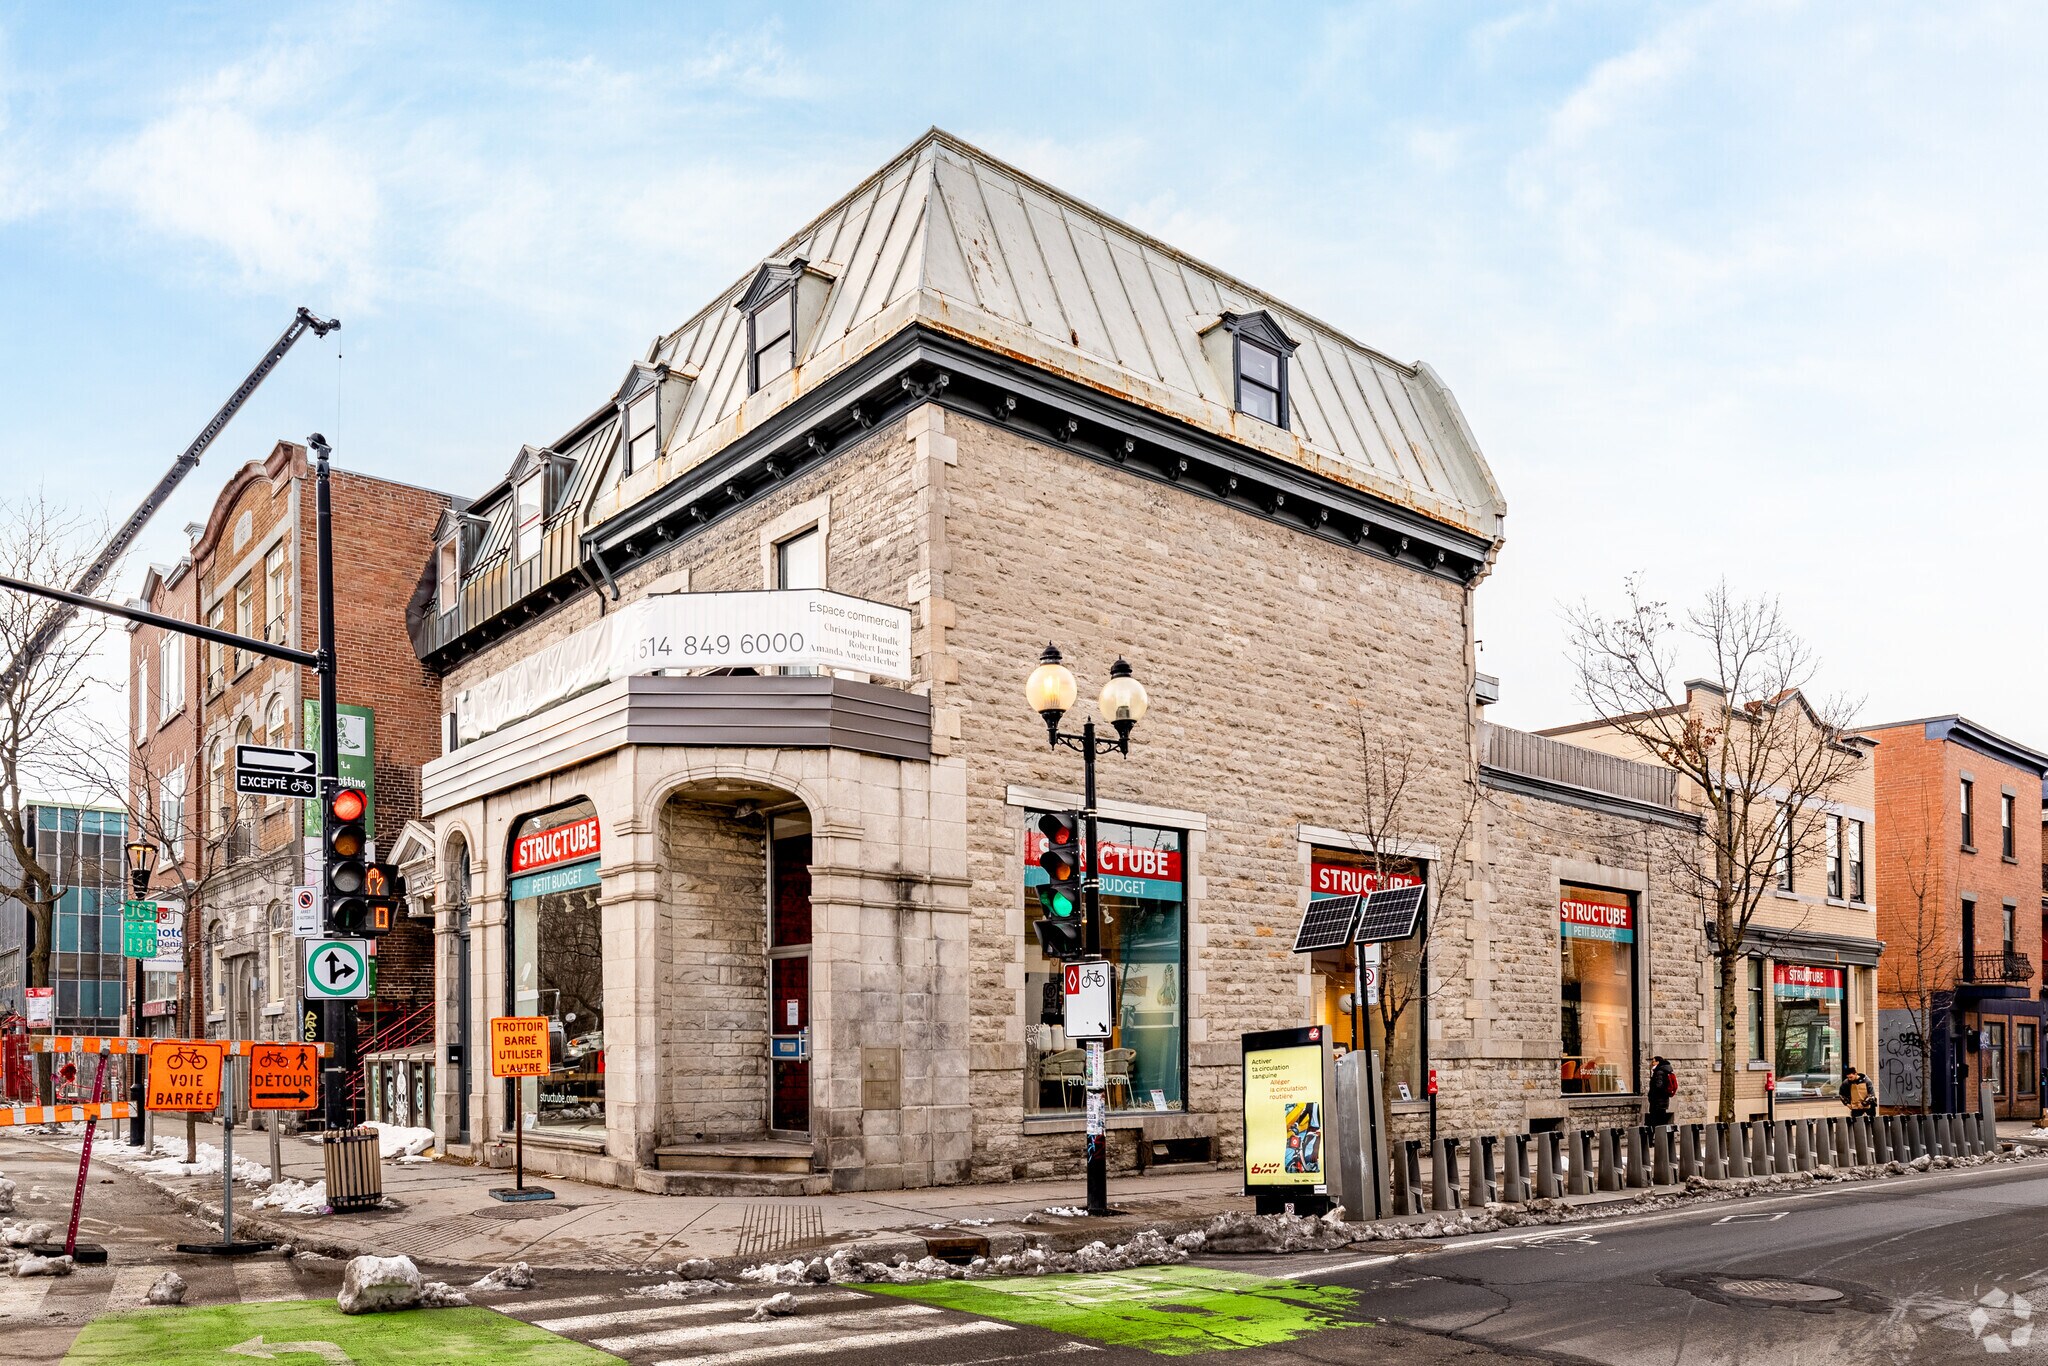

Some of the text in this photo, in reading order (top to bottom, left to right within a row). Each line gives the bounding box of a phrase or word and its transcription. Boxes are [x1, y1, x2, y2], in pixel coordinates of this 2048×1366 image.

[809, 601, 899, 630] Espace commercial
[824, 622, 870, 640] Christopher
[684, 634, 730, 655] 849
[740, 632, 804, 654] 6000
[809, 644, 843, 657] Amanda
[848, 639, 899, 656] Robert James
[240, 776, 287, 789] EXCEPTÉ
[338, 776, 366, 788] ottine
[520, 821, 597, 866] STRUCTUBE
[532, 869, 582, 893] PETIT BUDGET
[127, 904, 155, 918] JCT
[1561, 901, 1627, 926] STRUCTUBE
[1573, 926, 1616, 939] PETIT BUDGET
[129, 938, 153, 953] 138
[497, 1022, 543, 1032] TROTTOIR
[504, 1034, 537, 1046] BARRÉ
[499, 1050, 543, 1060] UTILISER
[501, 1063, 541, 1073] L'AUTRE
[170, 1074, 203, 1087] VOIE
[255, 1073, 312, 1087] DÉTOUR
[156, 1090, 213, 1105] BARRÉE
[540, 1092, 578, 1104] structube.com
